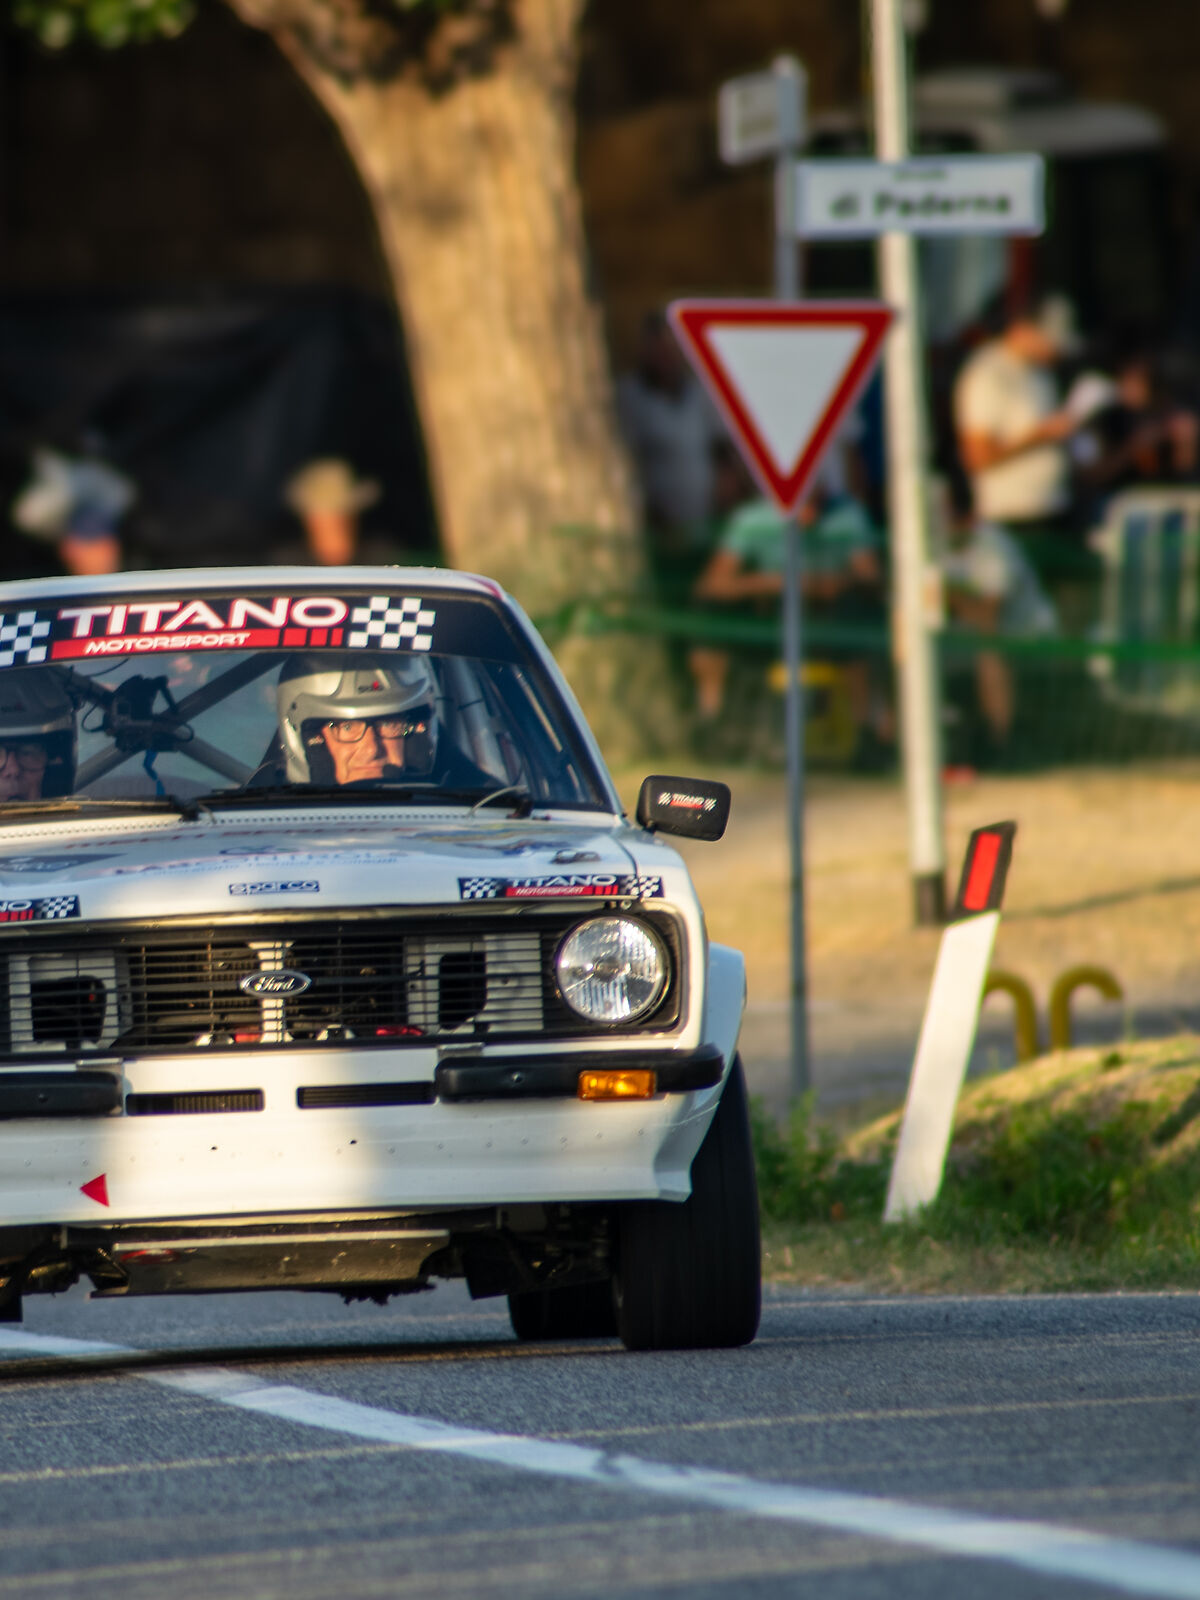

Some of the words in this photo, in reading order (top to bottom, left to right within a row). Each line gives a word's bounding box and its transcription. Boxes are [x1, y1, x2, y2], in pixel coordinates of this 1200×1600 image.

[58, 597, 349, 638] TITANO
[84, 632, 252, 655] MOTORSPORT
[506, 874, 617, 888] TITANO
[515, 886, 586, 896] MOTORSPORT
[254, 975, 296, 992] Ford
